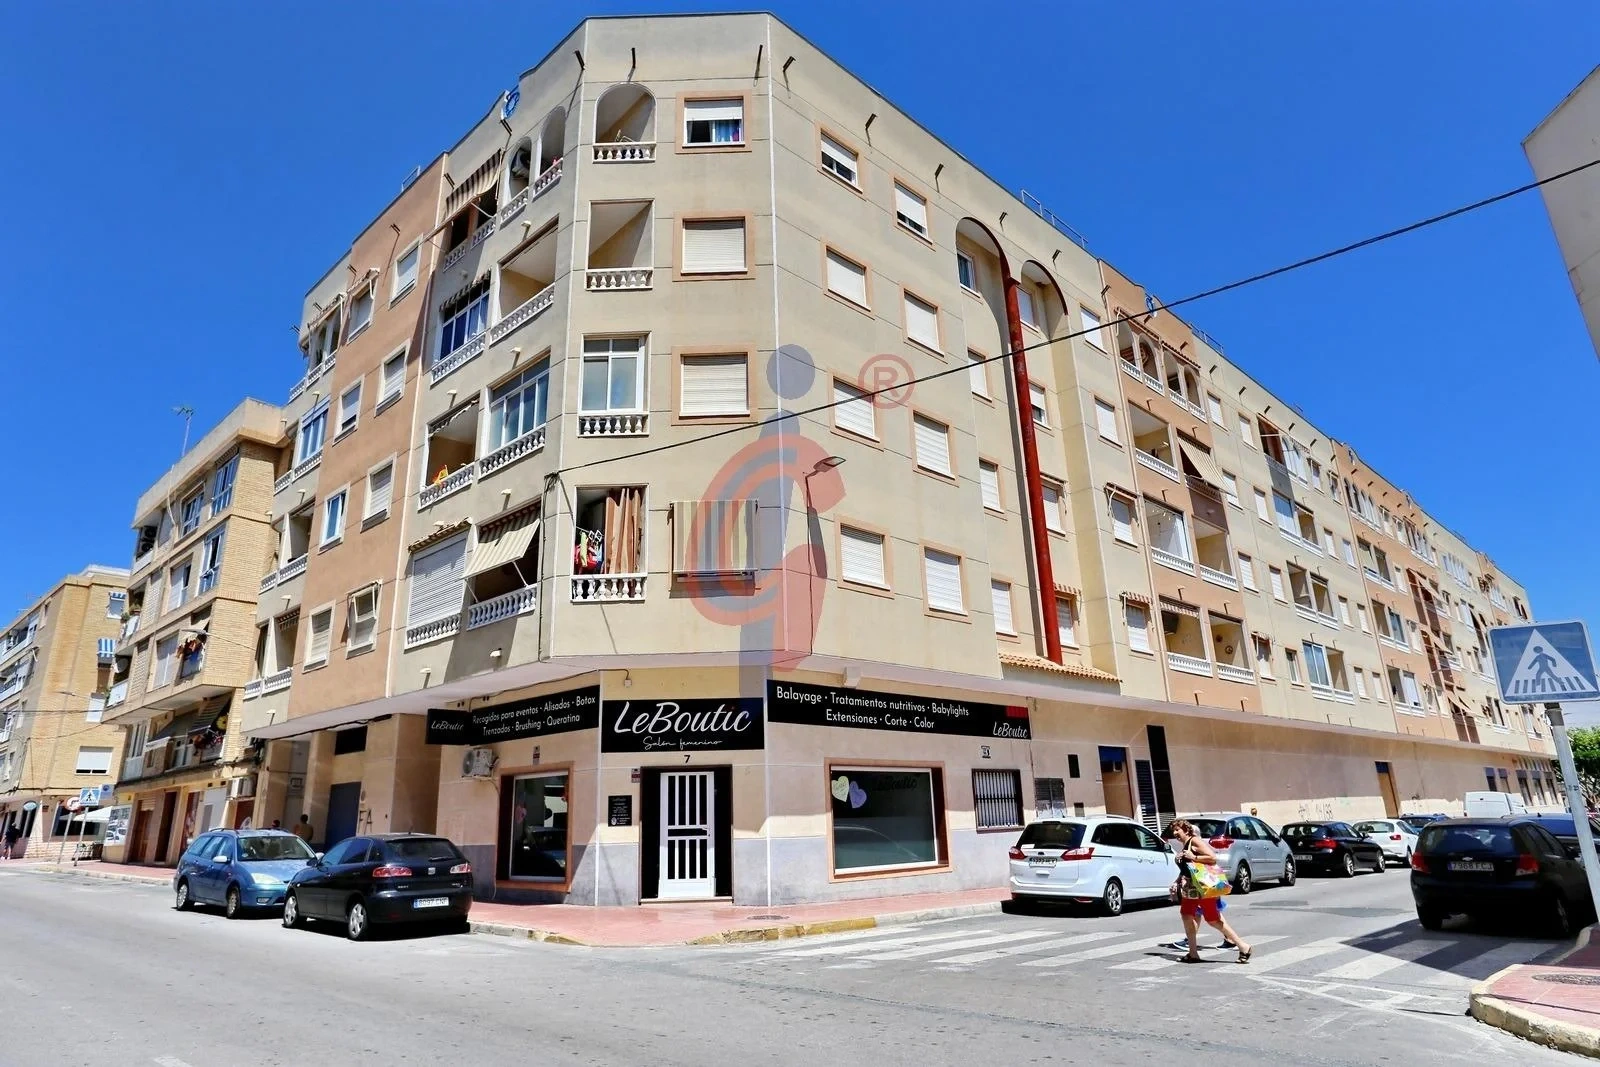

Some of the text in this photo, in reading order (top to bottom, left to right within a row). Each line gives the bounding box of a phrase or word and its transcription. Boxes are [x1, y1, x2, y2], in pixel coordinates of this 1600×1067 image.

[472, 695, 596, 725] Recogidos para eventos Alisados Botox
[776, 686, 970, 717] Balayage Tratamientos nutritivos Babylights
[431, 720, 465, 732] LeBoutic
[483, 714, 580, 736] Trenzados Brushing Queratina
[614, 701, 752, 734] LeBoutic
[826, 708, 935, 729] Extensiones Corte Color
[992, 721, 1028, 738] LeBoutic
[679, 738, 723, 750] femenino
[683, 754, 691, 763] 7
